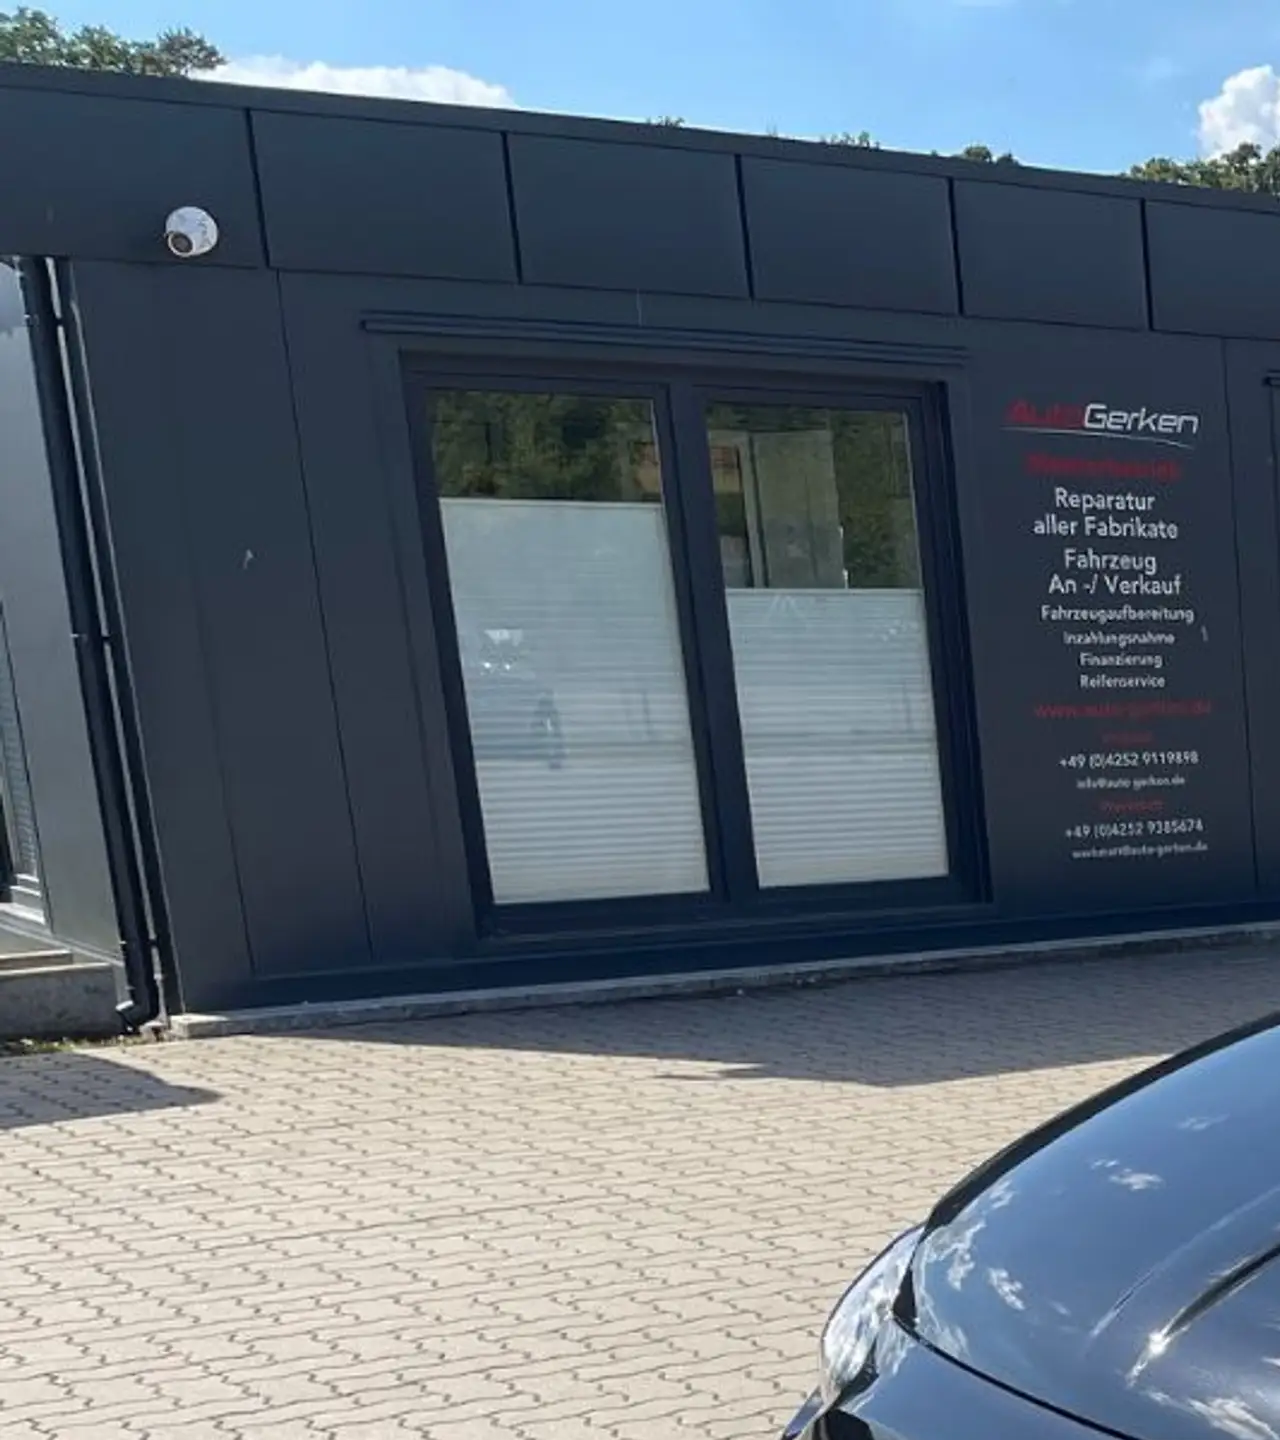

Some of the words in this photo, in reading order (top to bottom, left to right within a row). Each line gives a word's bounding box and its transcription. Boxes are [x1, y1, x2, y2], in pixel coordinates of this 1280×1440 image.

[1055, 487, 1156, 514] Reparatur
[1033, 514, 1079, 535] aller
[1084, 516, 1179, 539] Fabrikate
[1064, 548, 1157, 575] Fahrzeug
[1048, 574, 1077, 595] An
[1104, 574, 1182, 595] Verkauf
[1041, 605, 1195, 624] Fahrzeugaufbereitung
[1063, 631, 1176, 648] Inzahlungsnahme
[1079, 652, 1163, 668] Finanzierung
[1079, 674, 1166, 688] Reifenservice
[1059, 753, 1086, 768] +49
[1089, 752, 1139, 769] (0)4252
[1065, 824, 1091, 839] +49
